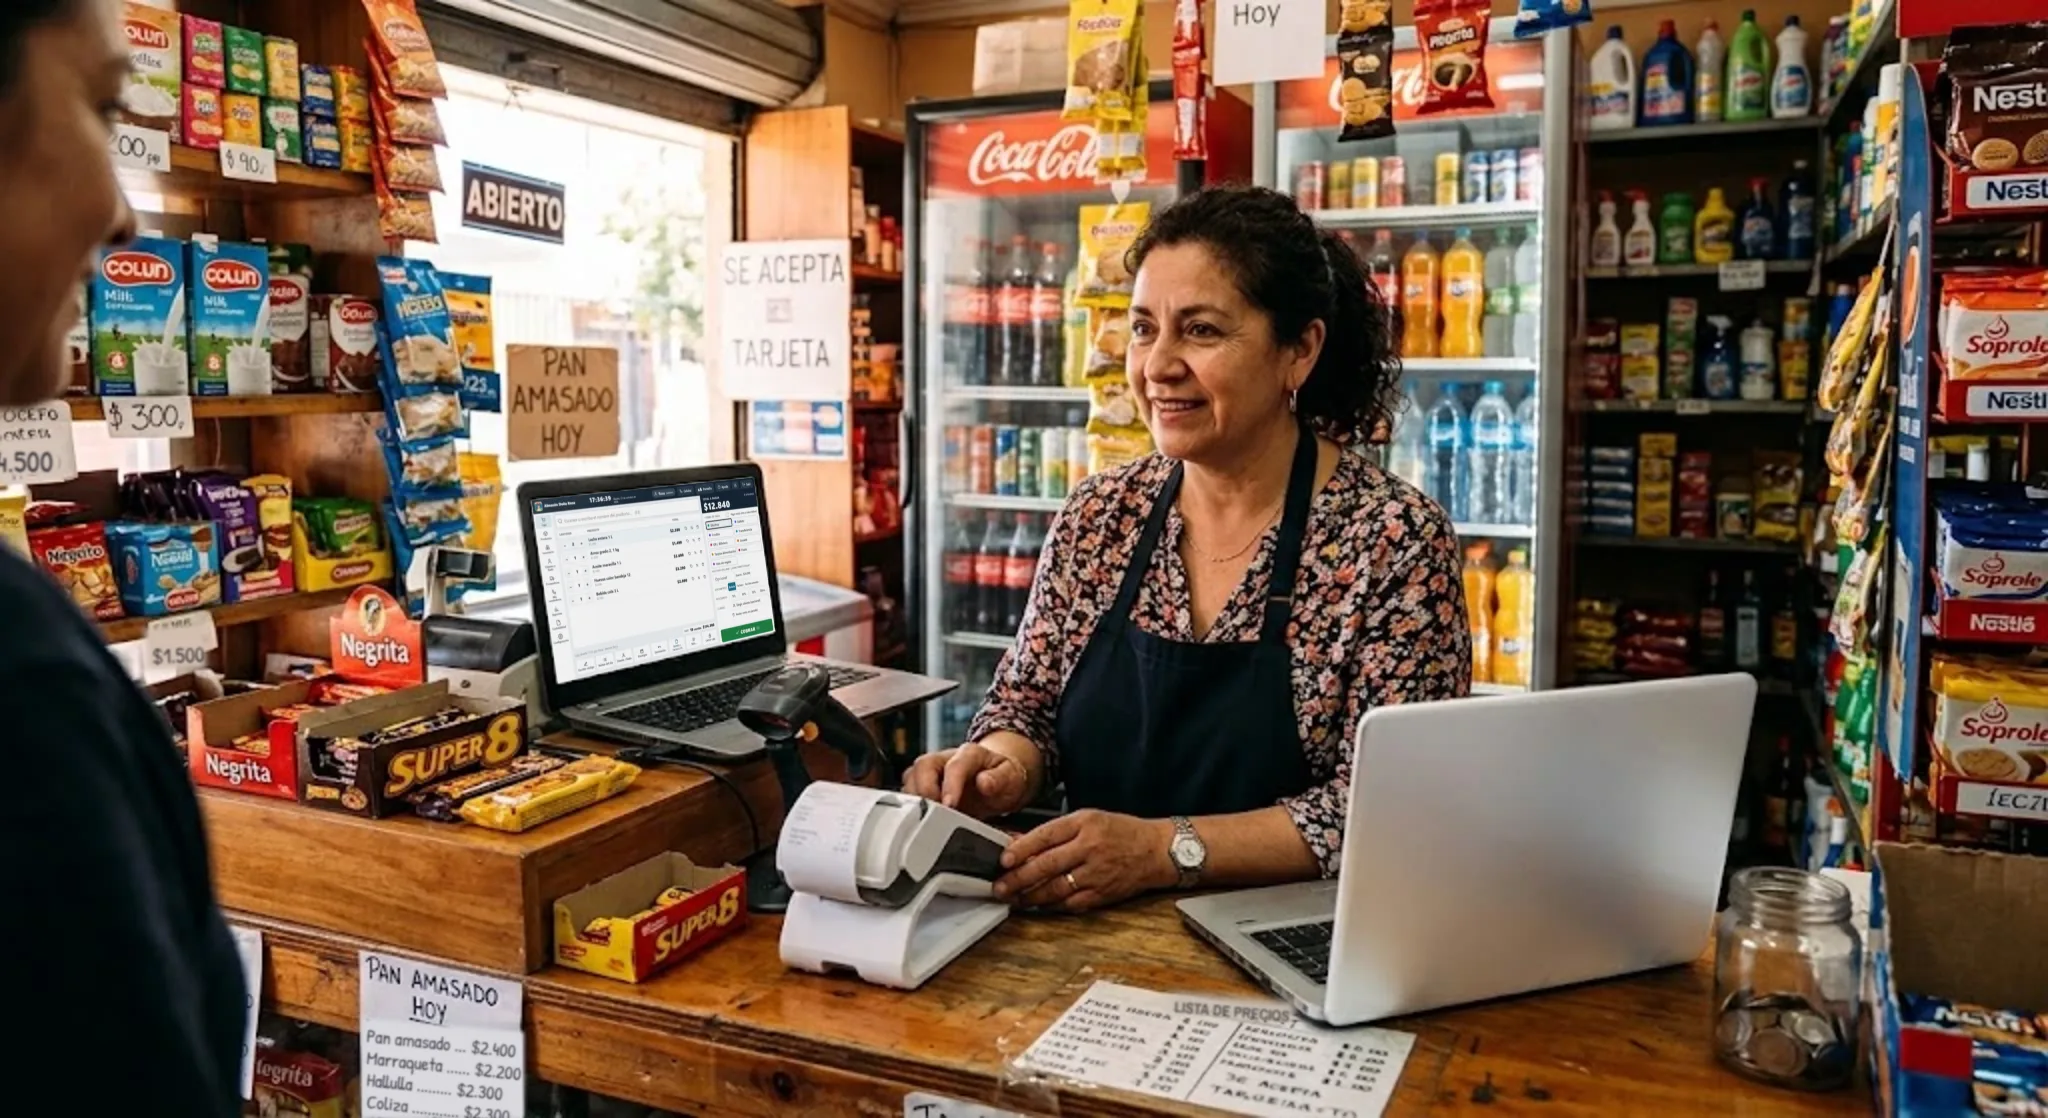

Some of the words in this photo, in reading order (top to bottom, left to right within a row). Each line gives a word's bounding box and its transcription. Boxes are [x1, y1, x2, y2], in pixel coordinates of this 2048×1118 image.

[1233, 3, 1281, 26] Hoy
[466, 178, 563, 231] ABIERTO
[724, 256, 751, 285] SE
[758, 253, 845, 284] ACEPTA
[543, 347, 586, 377] PAN
[732, 339, 831, 368] TARJETA
[511, 385, 615, 414] AMASADO
[109, 401, 123, 431] $
[541, 424, 585, 456] HOY
[703, 500, 731, 512] $12.840
[1962, 567, 2043, 589] Soprole
[152, 646, 205, 666] $1.500
[340, 632, 410, 667] Negrita
[206, 753, 272, 785] Negrita
[385, 732, 486, 798] SUPER
[486, 711, 523, 766] 8
[654, 904, 718, 963] SUPER
[716, 886, 741, 927] 8
[366, 956, 401, 985] PAN
[411, 970, 499, 1007] AMASADO
[412, 996, 448, 1025] HOY
[1174, 1002, 1210, 1016] LISTA
[1213, 1003, 1233, 1016] DE
[366, 1030, 391, 1045] Pan
[395, 1035, 451, 1051] amasado
[472, 1040, 517, 1058] $2.400
[366, 1052, 443, 1075] Marraqueta
[475, 1062, 522, 1081] $2.200
[366, 1074, 414, 1092] Hallulla
[457, 1083, 504, 1101] $2.300
[366, 1096, 410, 1113] Coliza
